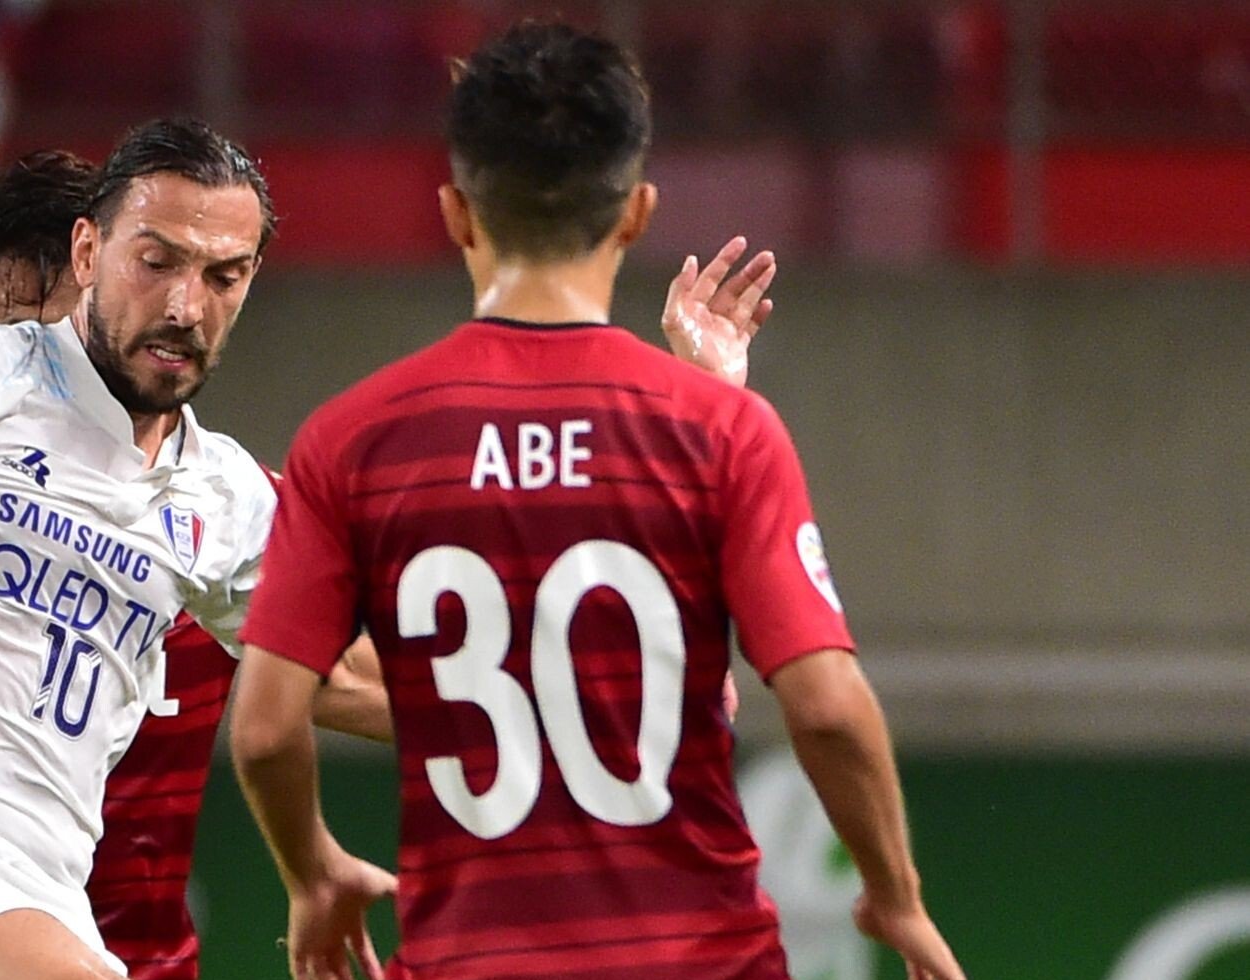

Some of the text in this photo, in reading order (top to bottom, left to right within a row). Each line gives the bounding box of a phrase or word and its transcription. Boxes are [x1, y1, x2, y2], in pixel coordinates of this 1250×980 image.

[470, 419, 593, 491] ABE
[113, 599, 172, 662] TV
[28, 620, 103, 742] 10
[396, 538, 687, 841] 30
